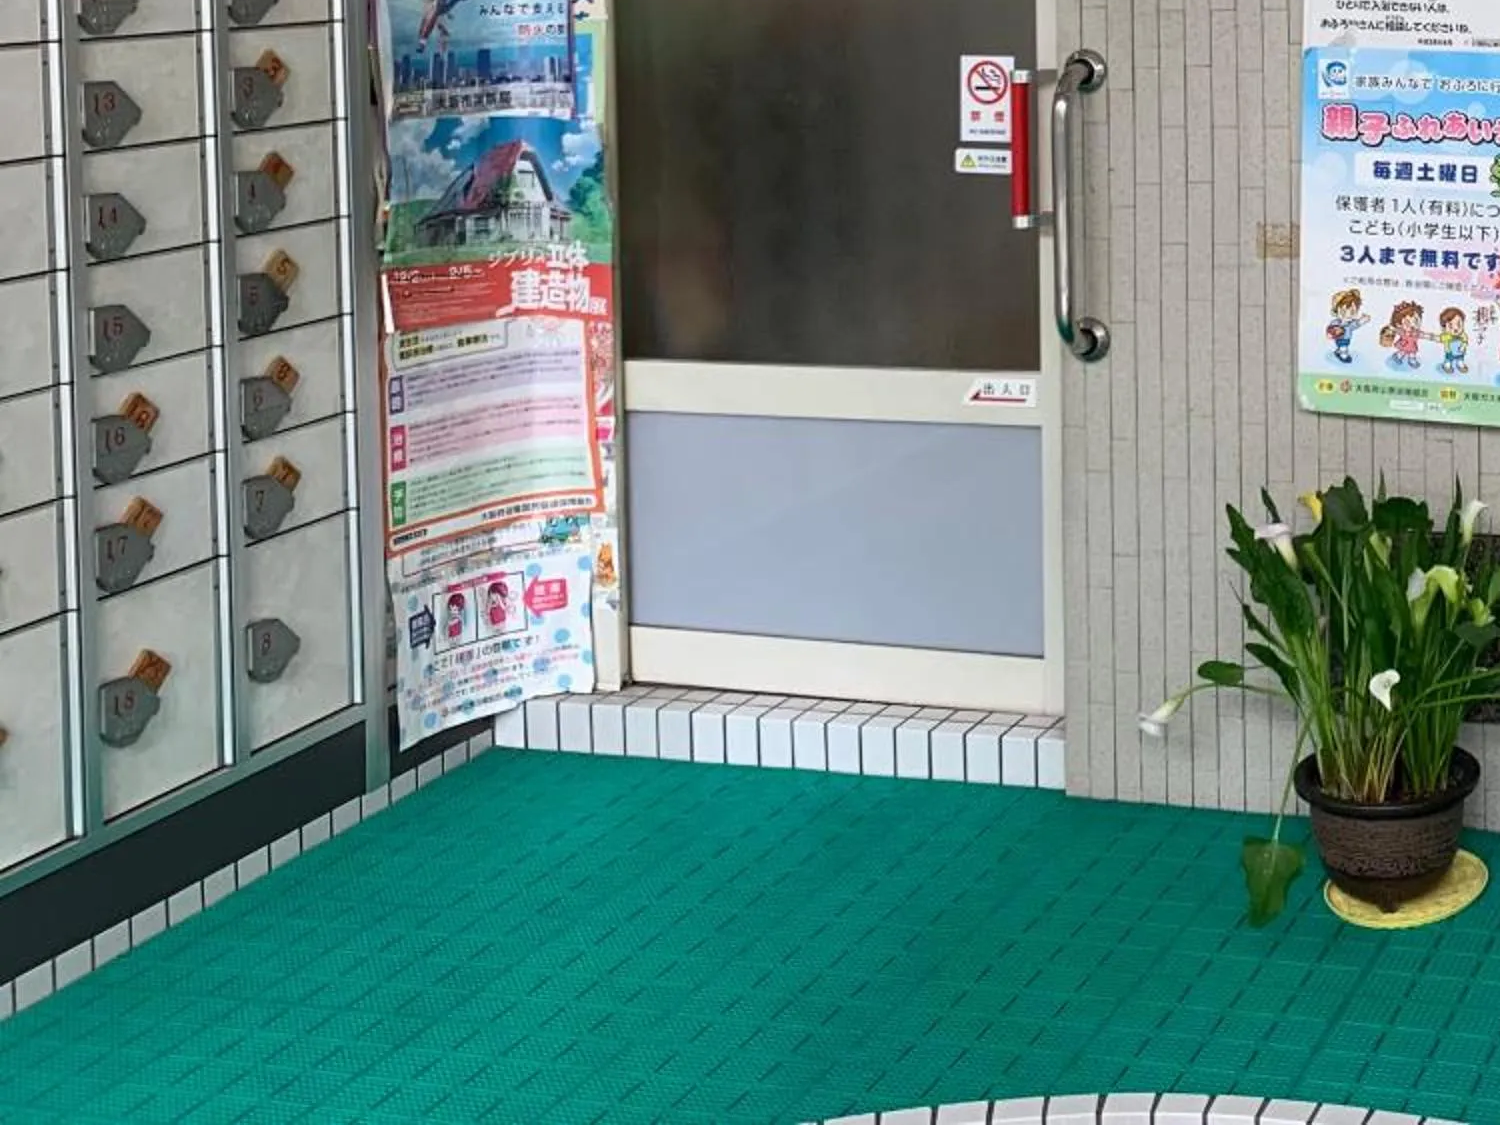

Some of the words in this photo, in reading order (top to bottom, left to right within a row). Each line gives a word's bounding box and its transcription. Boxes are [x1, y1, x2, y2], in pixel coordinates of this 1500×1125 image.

[94, 91, 117, 116] 13
[1373, 160, 1478, 184] 毎週土曜日
[105, 426, 126, 453] 16
[107, 536, 129, 561] 17
